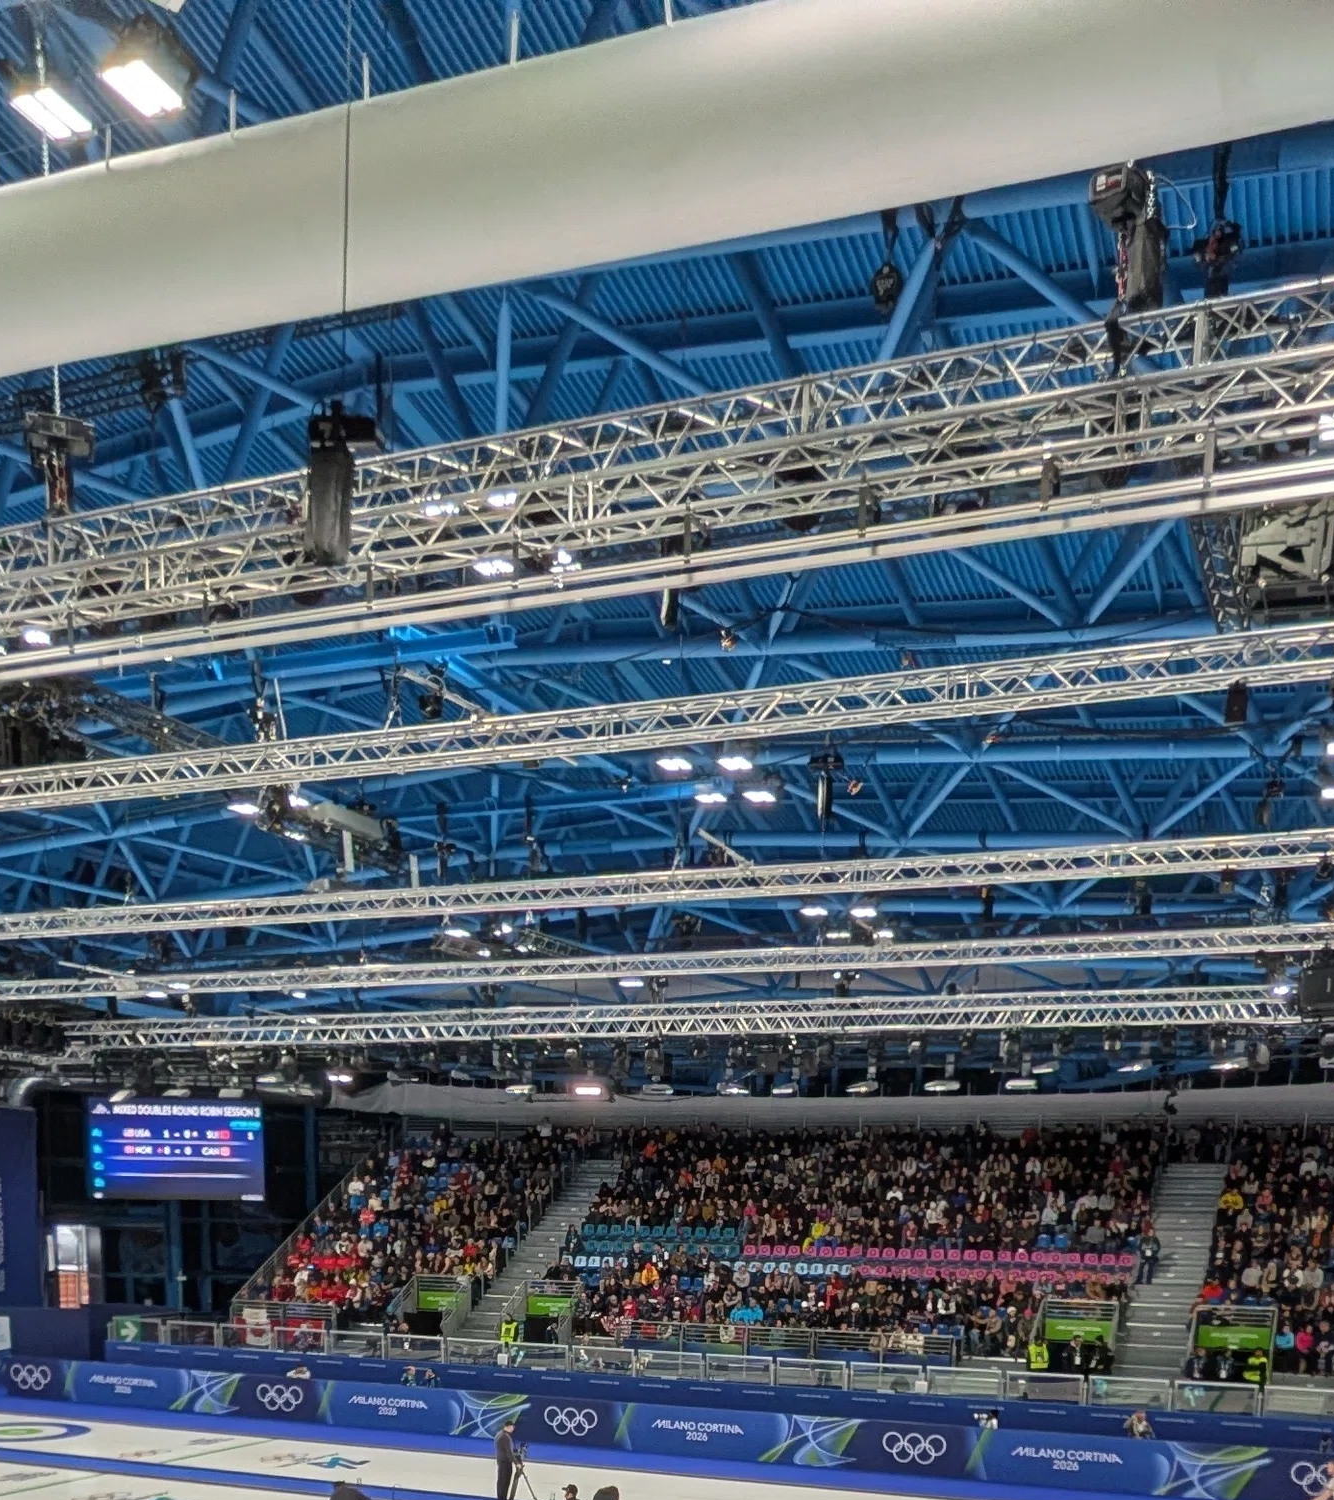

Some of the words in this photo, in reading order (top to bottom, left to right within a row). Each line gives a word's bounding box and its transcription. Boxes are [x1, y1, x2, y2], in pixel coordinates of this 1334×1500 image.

[348, 1395, 386, 1406] MILANO
[387, 1398, 428, 1409] CORTINA
[651, 1419, 696, 1431] MILANO
[697, 1422, 744, 1435] CORTINA
[685, 1431, 708, 1442] 2026
[1010, 1446, 1066, 1460] MILANO
[1067, 1450, 1124, 1465] CORTINA
[1052, 1460, 1080, 1471] 2026
